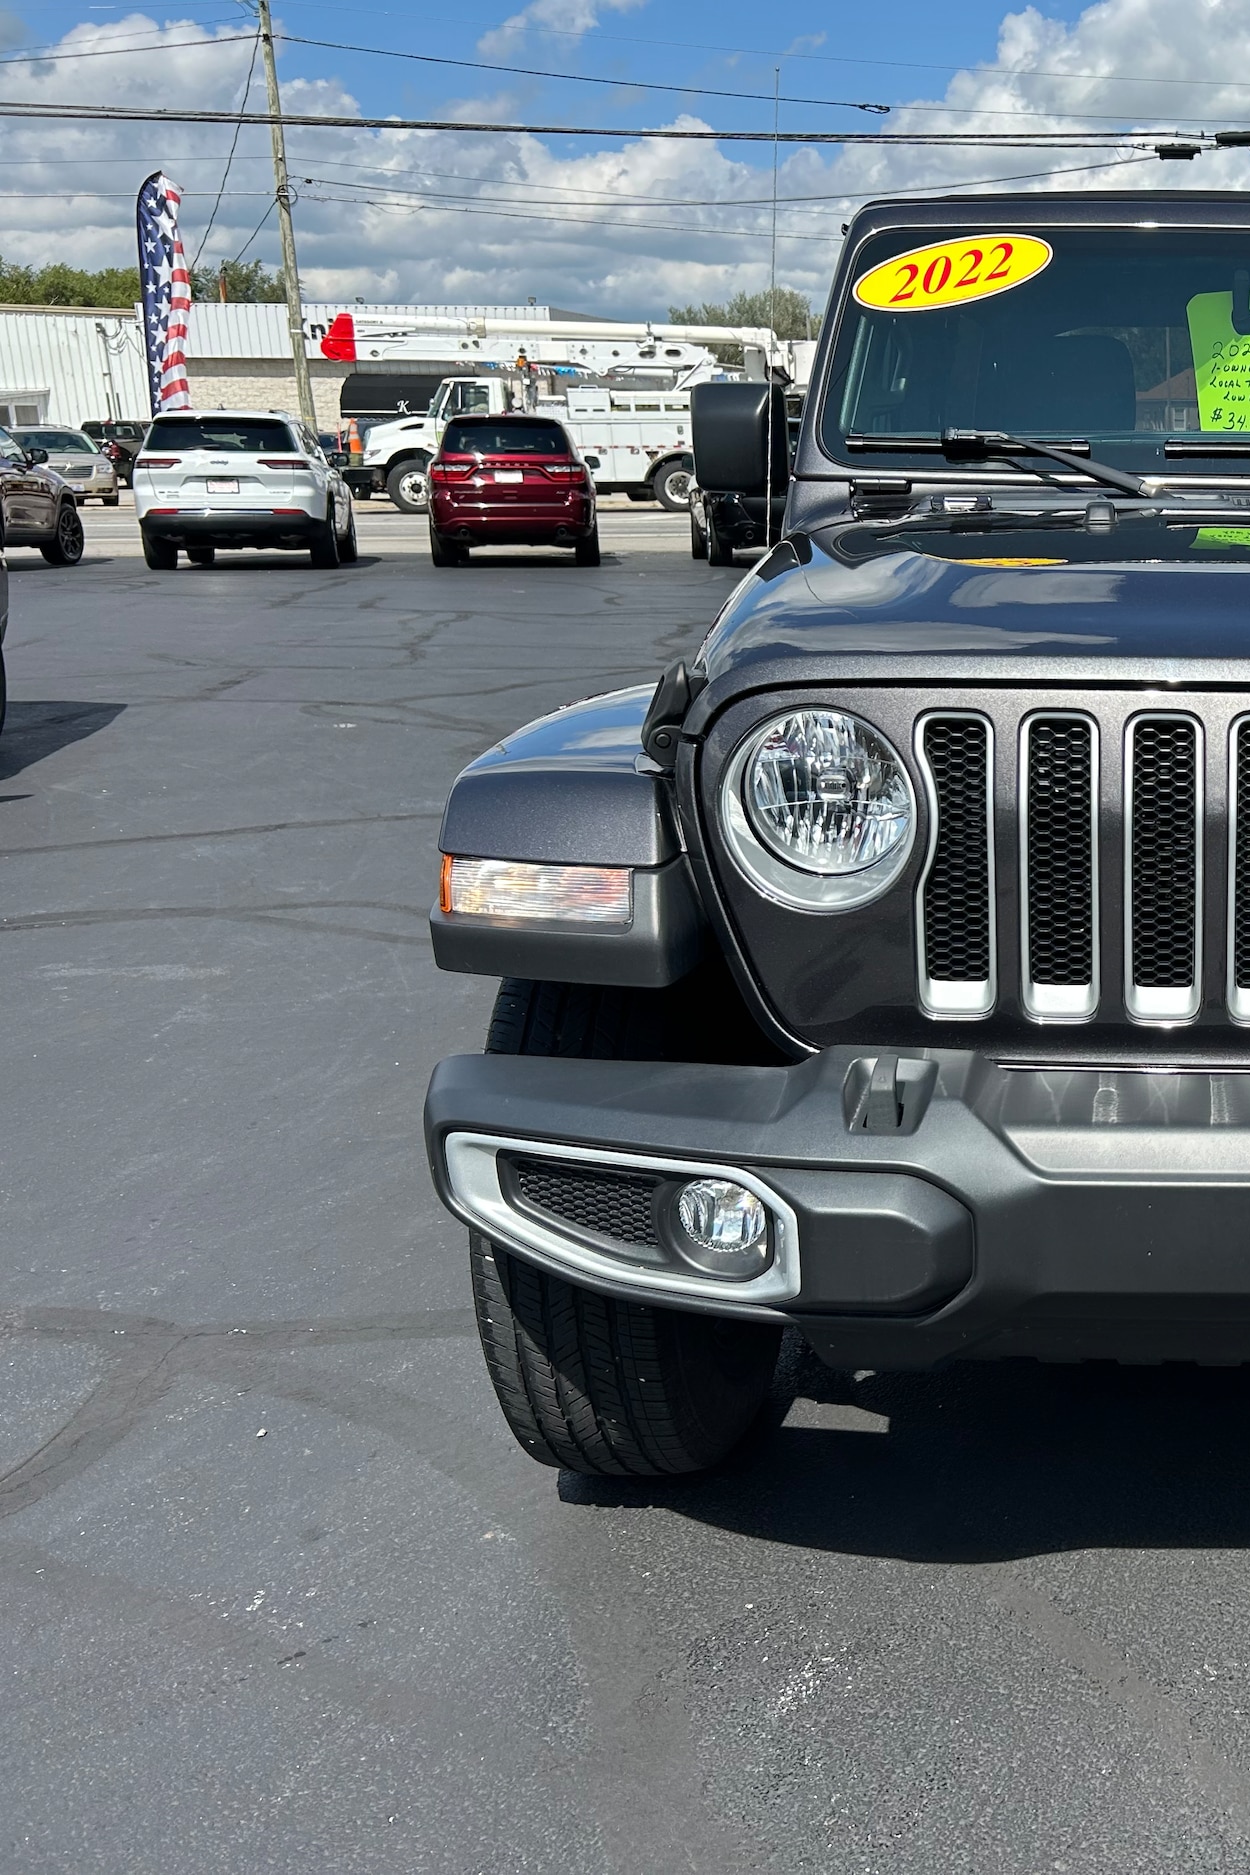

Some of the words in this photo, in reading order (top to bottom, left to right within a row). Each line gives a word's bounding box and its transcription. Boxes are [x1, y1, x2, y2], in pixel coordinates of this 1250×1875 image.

[888, 242, 1014, 304] 2022
[1209, 376, 1241, 388] LOCAL
[396, 400, 412, 415] K
